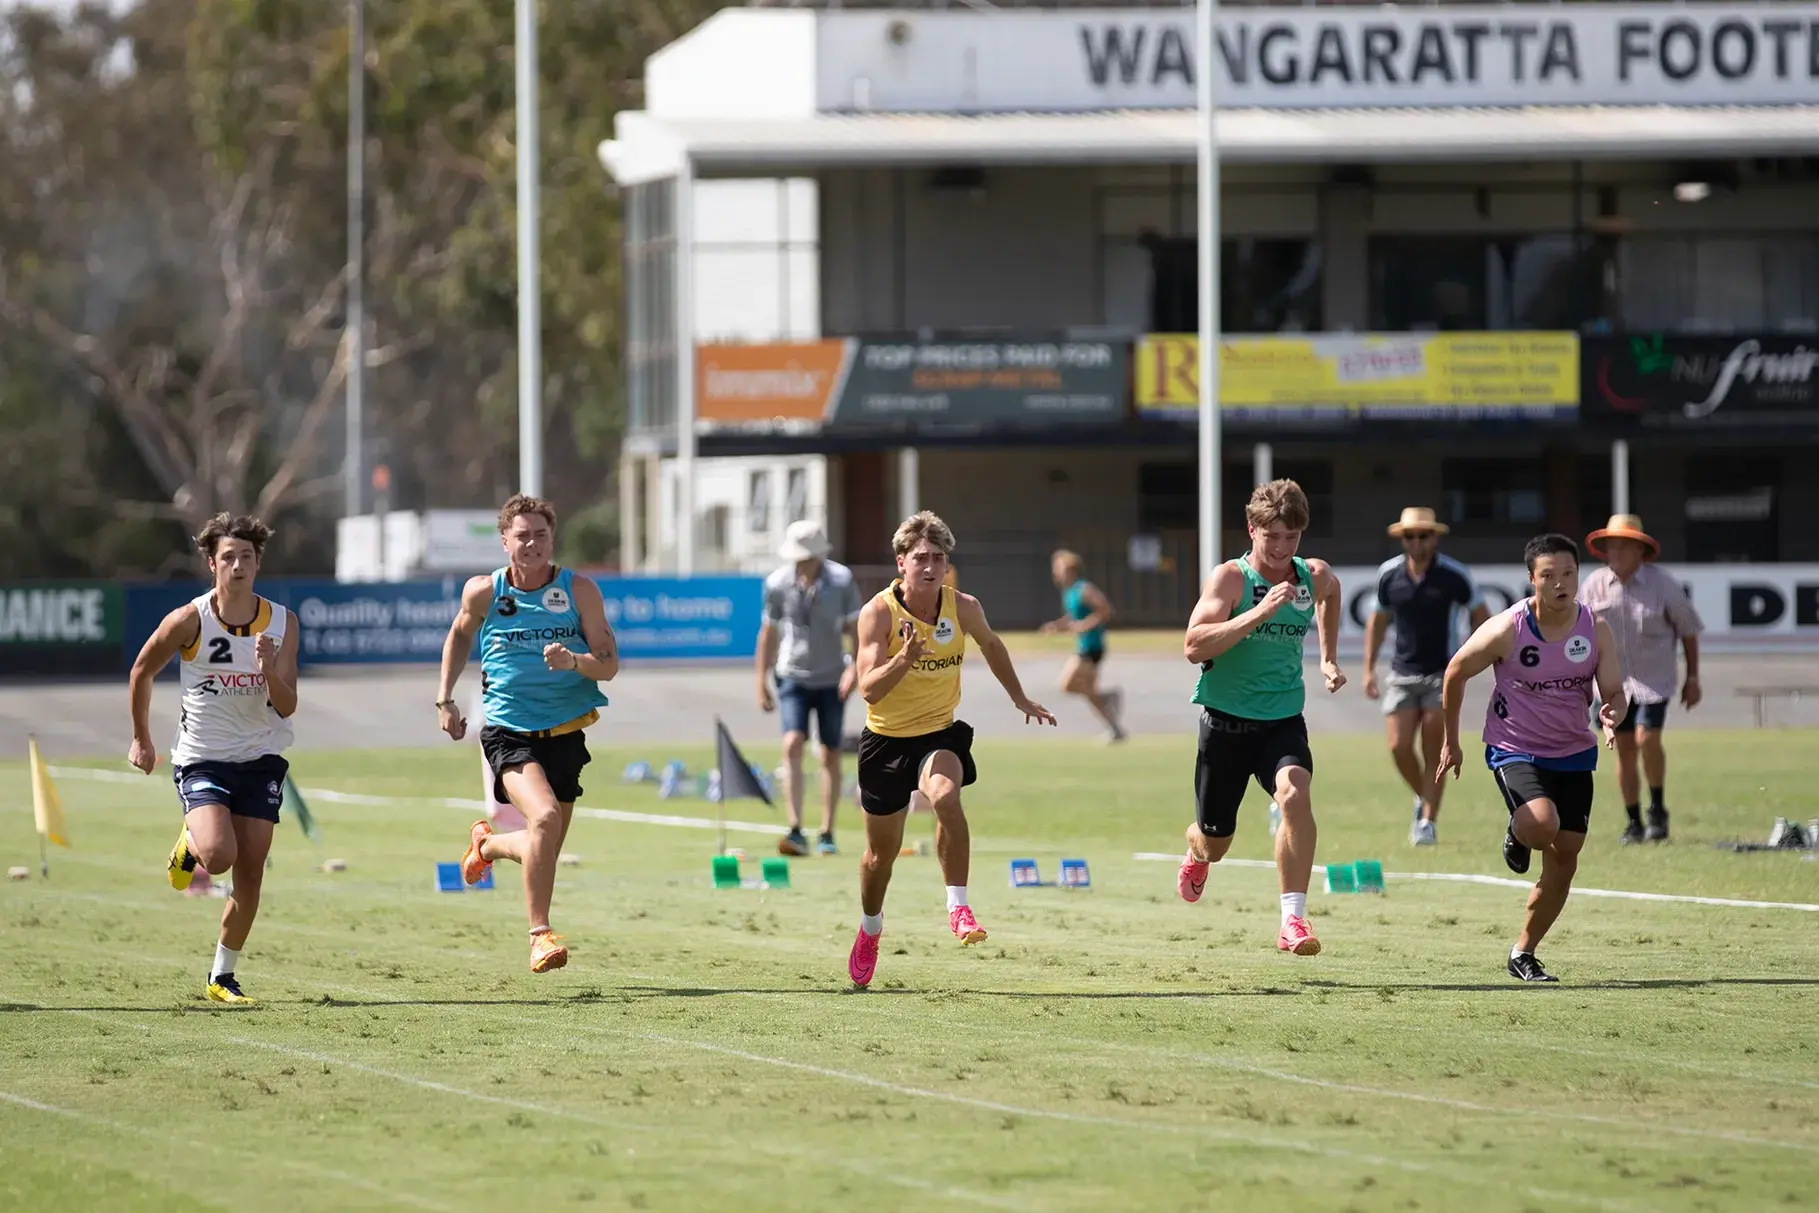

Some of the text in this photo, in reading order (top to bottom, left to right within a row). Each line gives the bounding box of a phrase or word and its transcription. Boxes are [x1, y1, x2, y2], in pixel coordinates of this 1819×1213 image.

[1080, 22, 1819, 84] WANGARATTA FOOT
[0, 589, 104, 641] ANCE
[498, 595, 517, 616] 3
[208, 637, 233, 663] 2
[1520, 645, 1540, 667] 6
